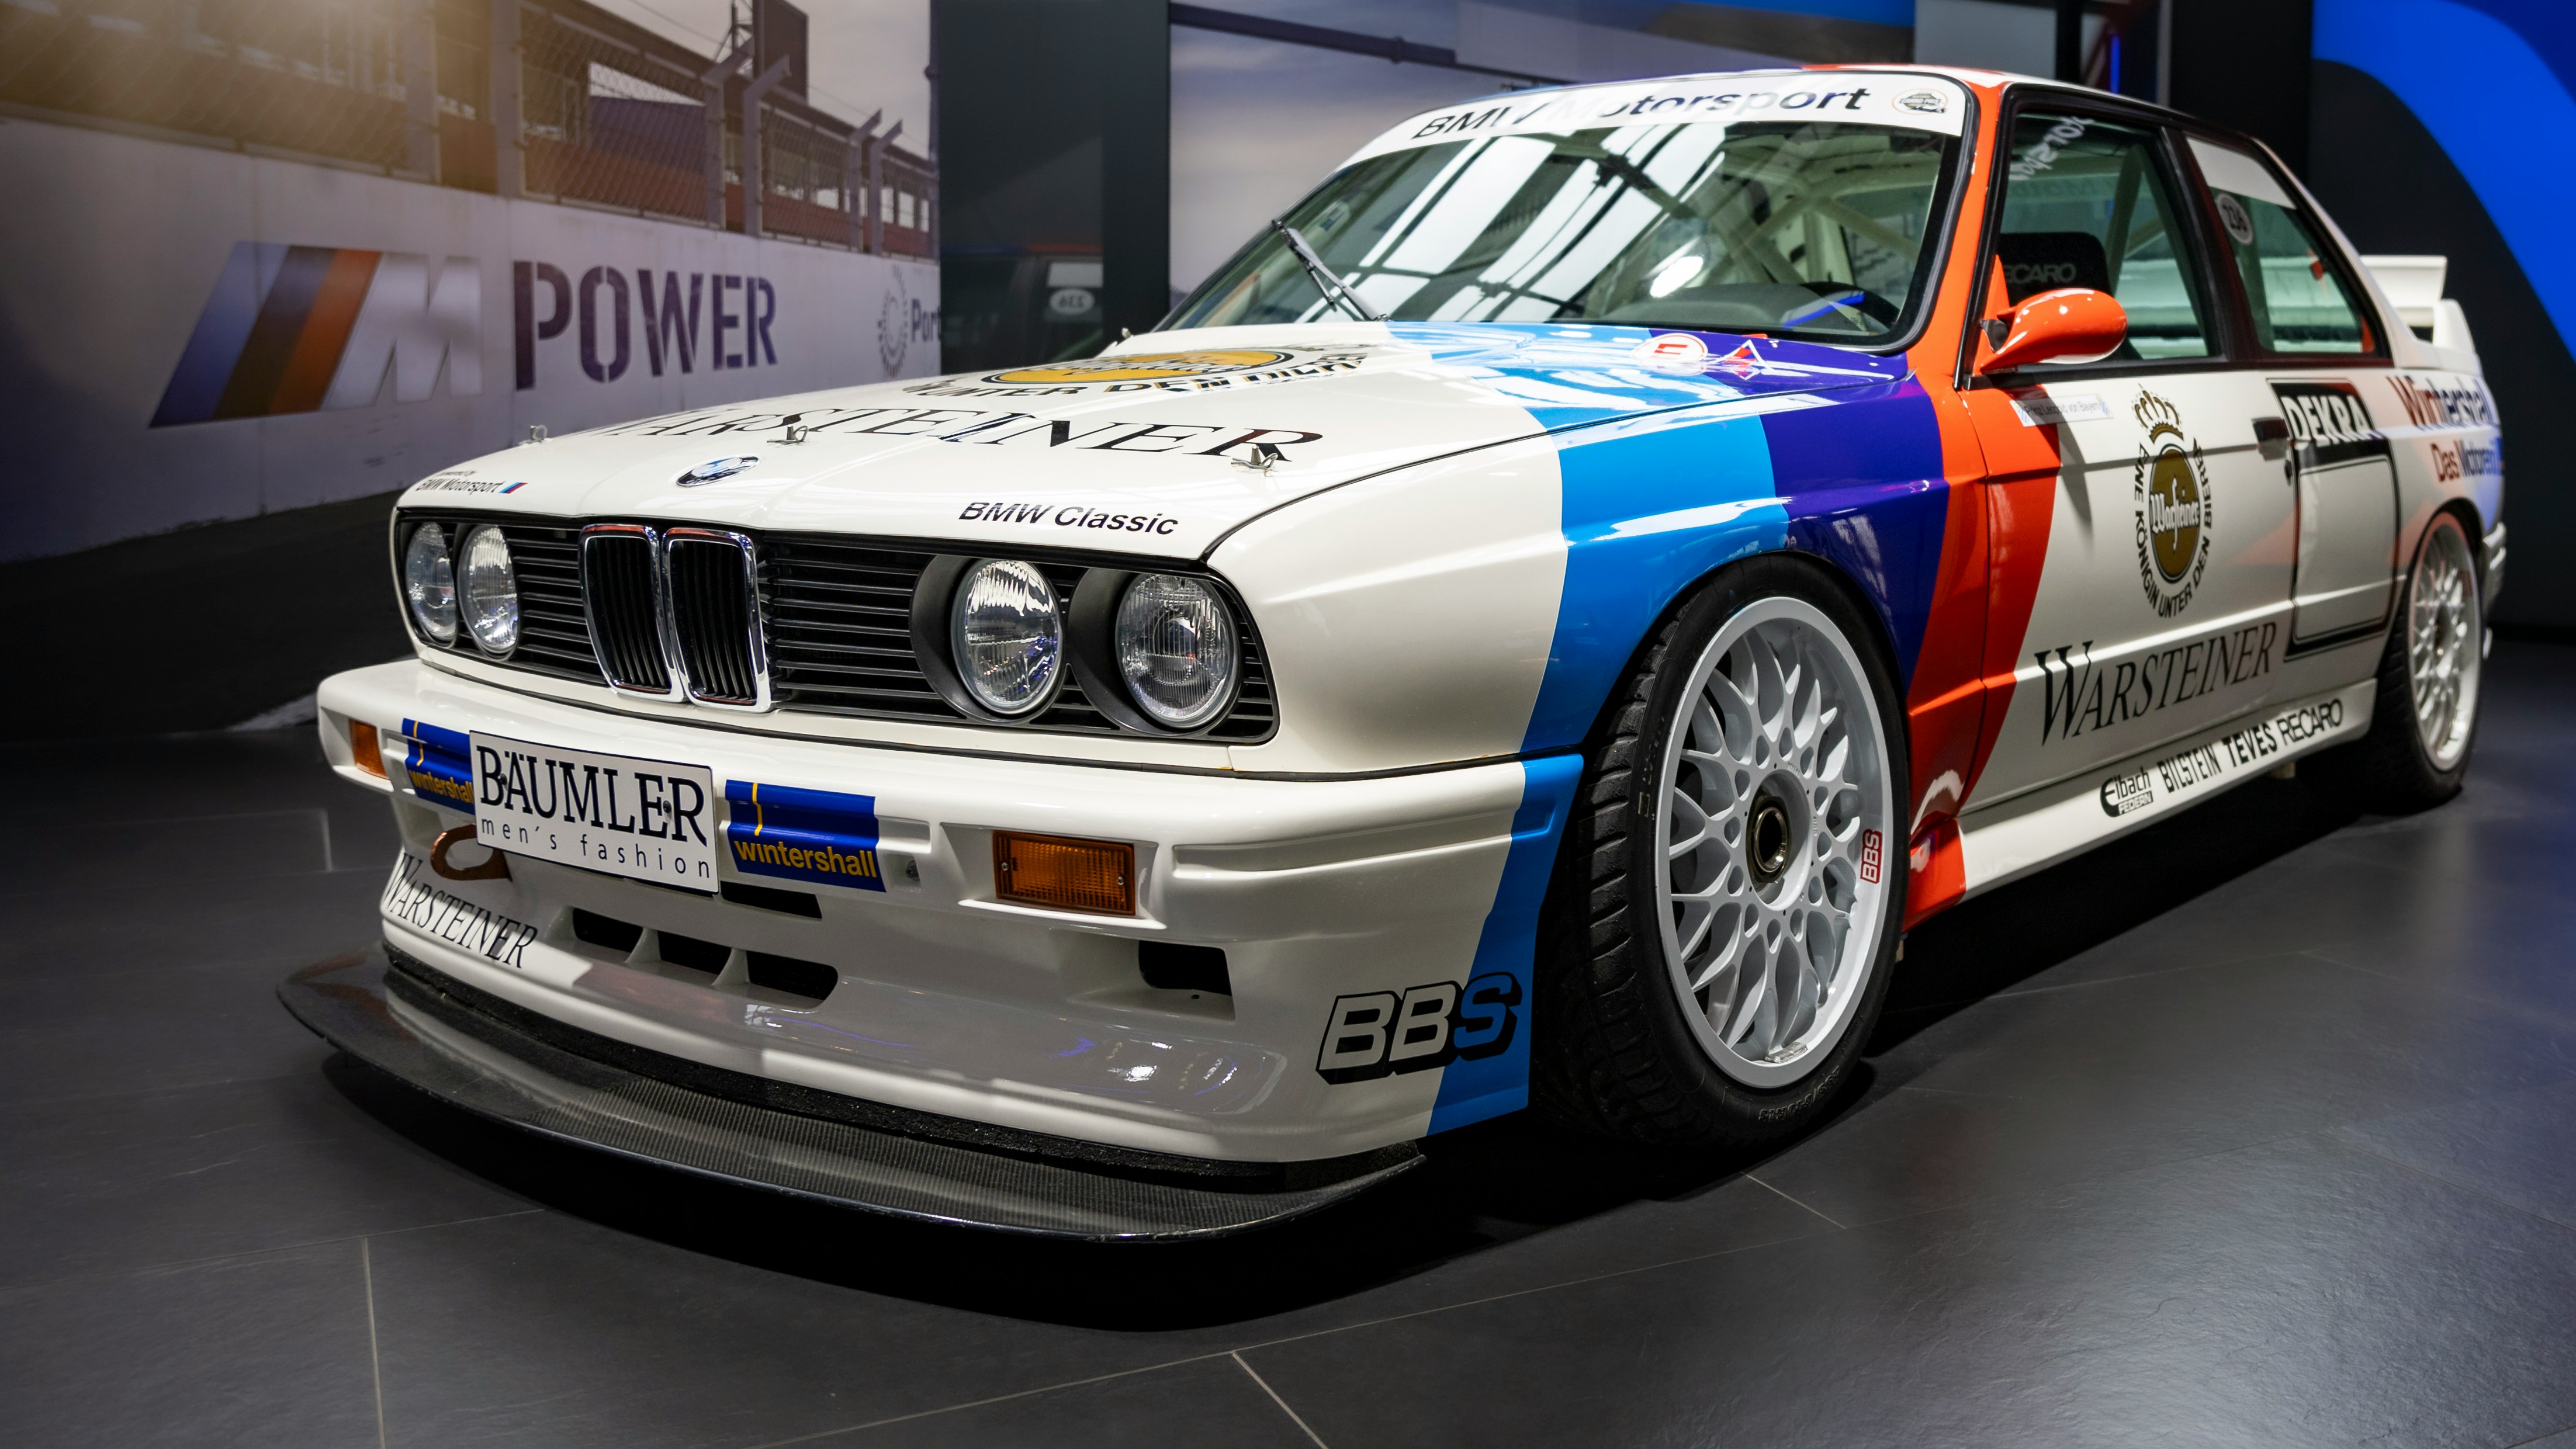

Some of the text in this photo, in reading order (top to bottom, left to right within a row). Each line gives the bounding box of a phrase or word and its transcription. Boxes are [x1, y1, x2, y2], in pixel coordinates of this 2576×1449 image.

[2004, 263, 2076, 284] ECARO
[514, 261, 778, 391] POWER
[2280, 394, 2371, 445] DEKRA
[439, 479, 506, 495] Motorsport
[2430, 443, 2460, 482] Das
[958, 501, 1178, 535] BMW Classic
[2135, 510, 2160, 609] KÖNIGIN
[2158, 581, 2193, 618] UNTER
[2193, 535, 2210, 590] DEN
[2034, 621, 2277, 747] WARSTEINER
[2157, 699, 2343, 793] BILSTEIN TEVES RECARO
[476, 745, 708, 847] BÄUMLER
[2100, 765, 2152, 818] Eibach
[2118, 792, 2152, 815] FEDERN
[580, 833, 710, 878] fashion
[733, 840, 877, 878] wintershall
[1861, 830, 1881, 883] BBS
[382, 852, 538, 969] WARSTEINER
[1315, 972, 1522, 1085] BBS
